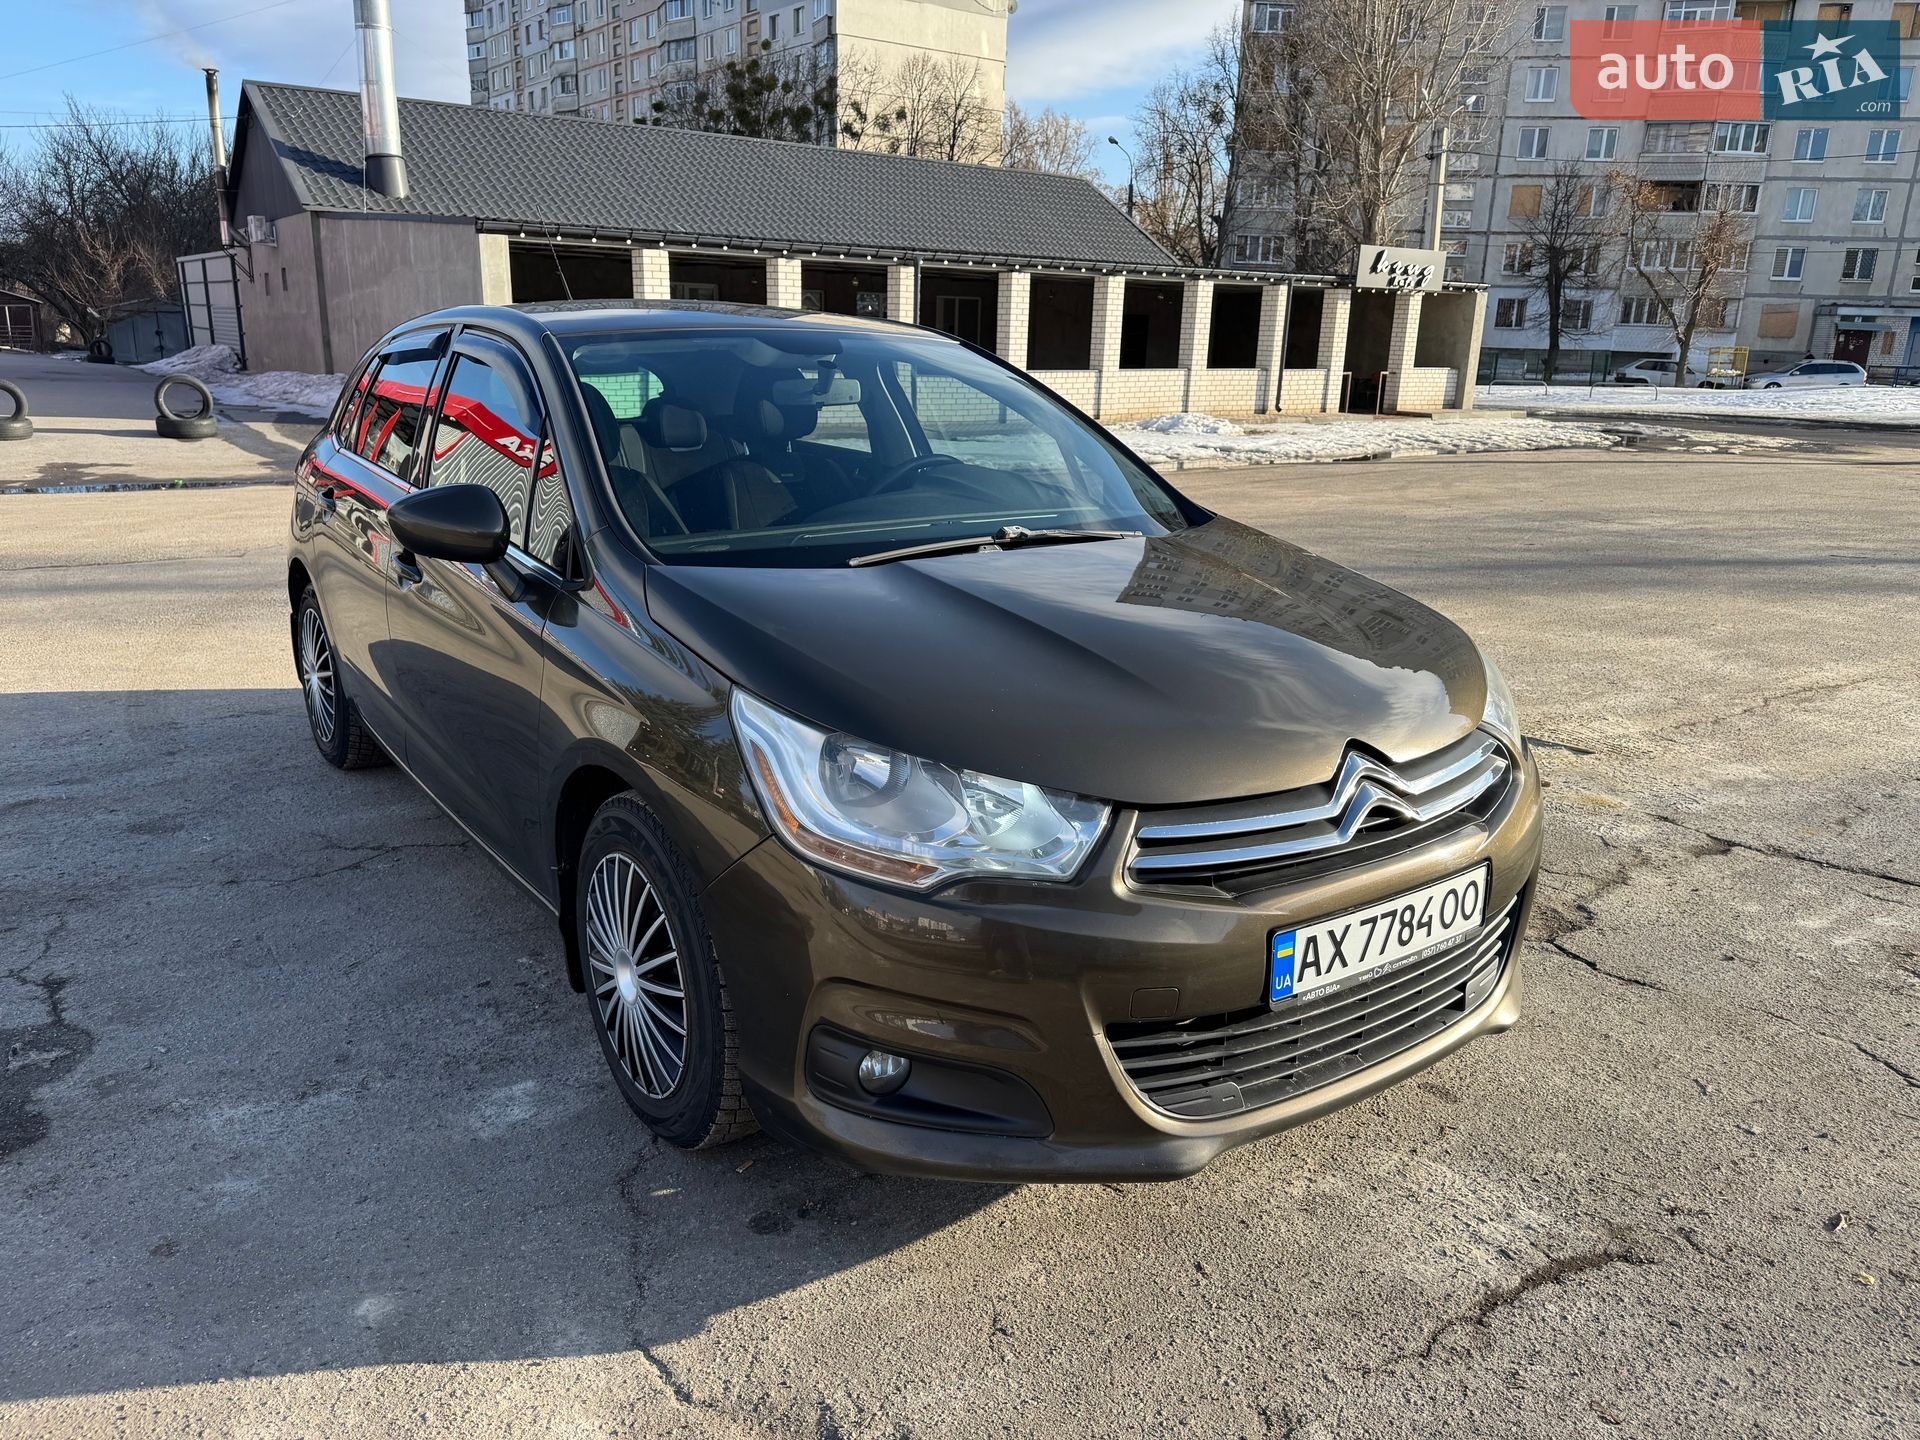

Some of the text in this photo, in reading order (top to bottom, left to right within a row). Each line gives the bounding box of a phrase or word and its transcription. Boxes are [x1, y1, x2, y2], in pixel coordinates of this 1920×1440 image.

[1297, 923, 1352, 983] AX
[1358, 895, 1434, 963] 7784
[1275, 974, 1292, 990] UA
